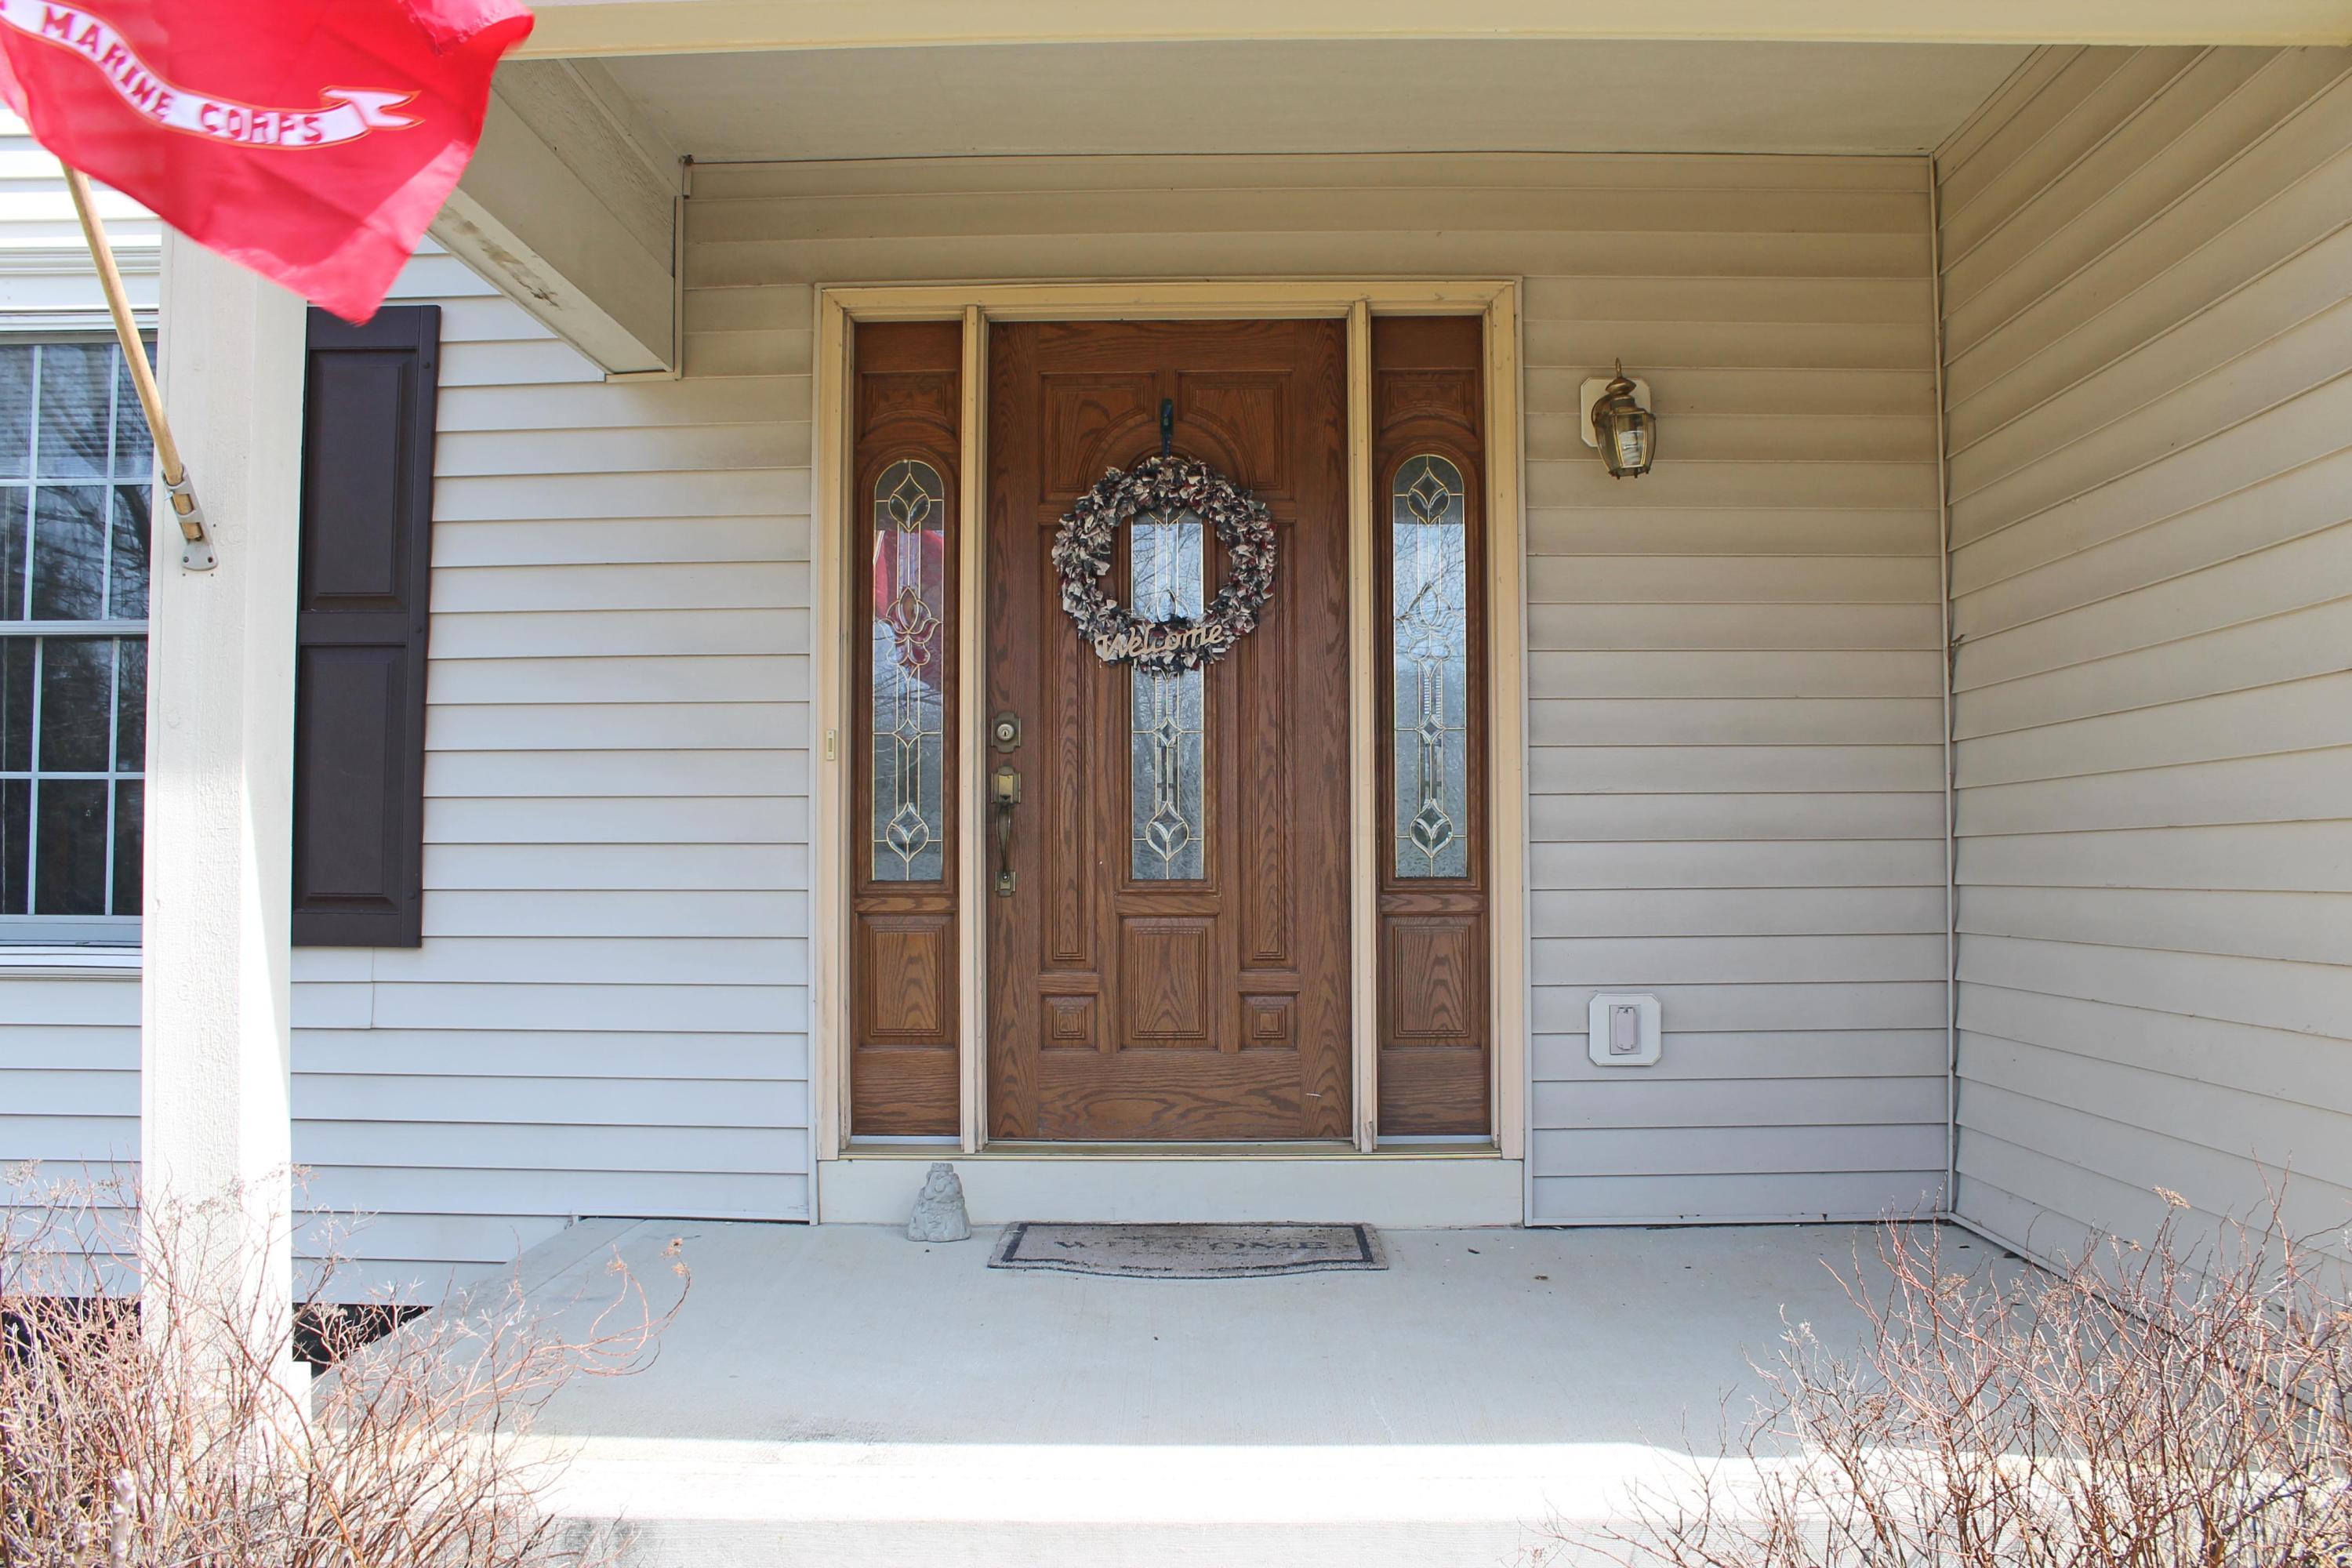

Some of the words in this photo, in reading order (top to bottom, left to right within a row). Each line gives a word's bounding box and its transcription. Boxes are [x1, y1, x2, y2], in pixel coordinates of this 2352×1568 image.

[42, 6, 174, 122] MARINE
[201, 103, 322, 143] CORPS
[1095, 624, 1225, 661] Welcome
[1054, 1240, 1330, 1250] WCOME
